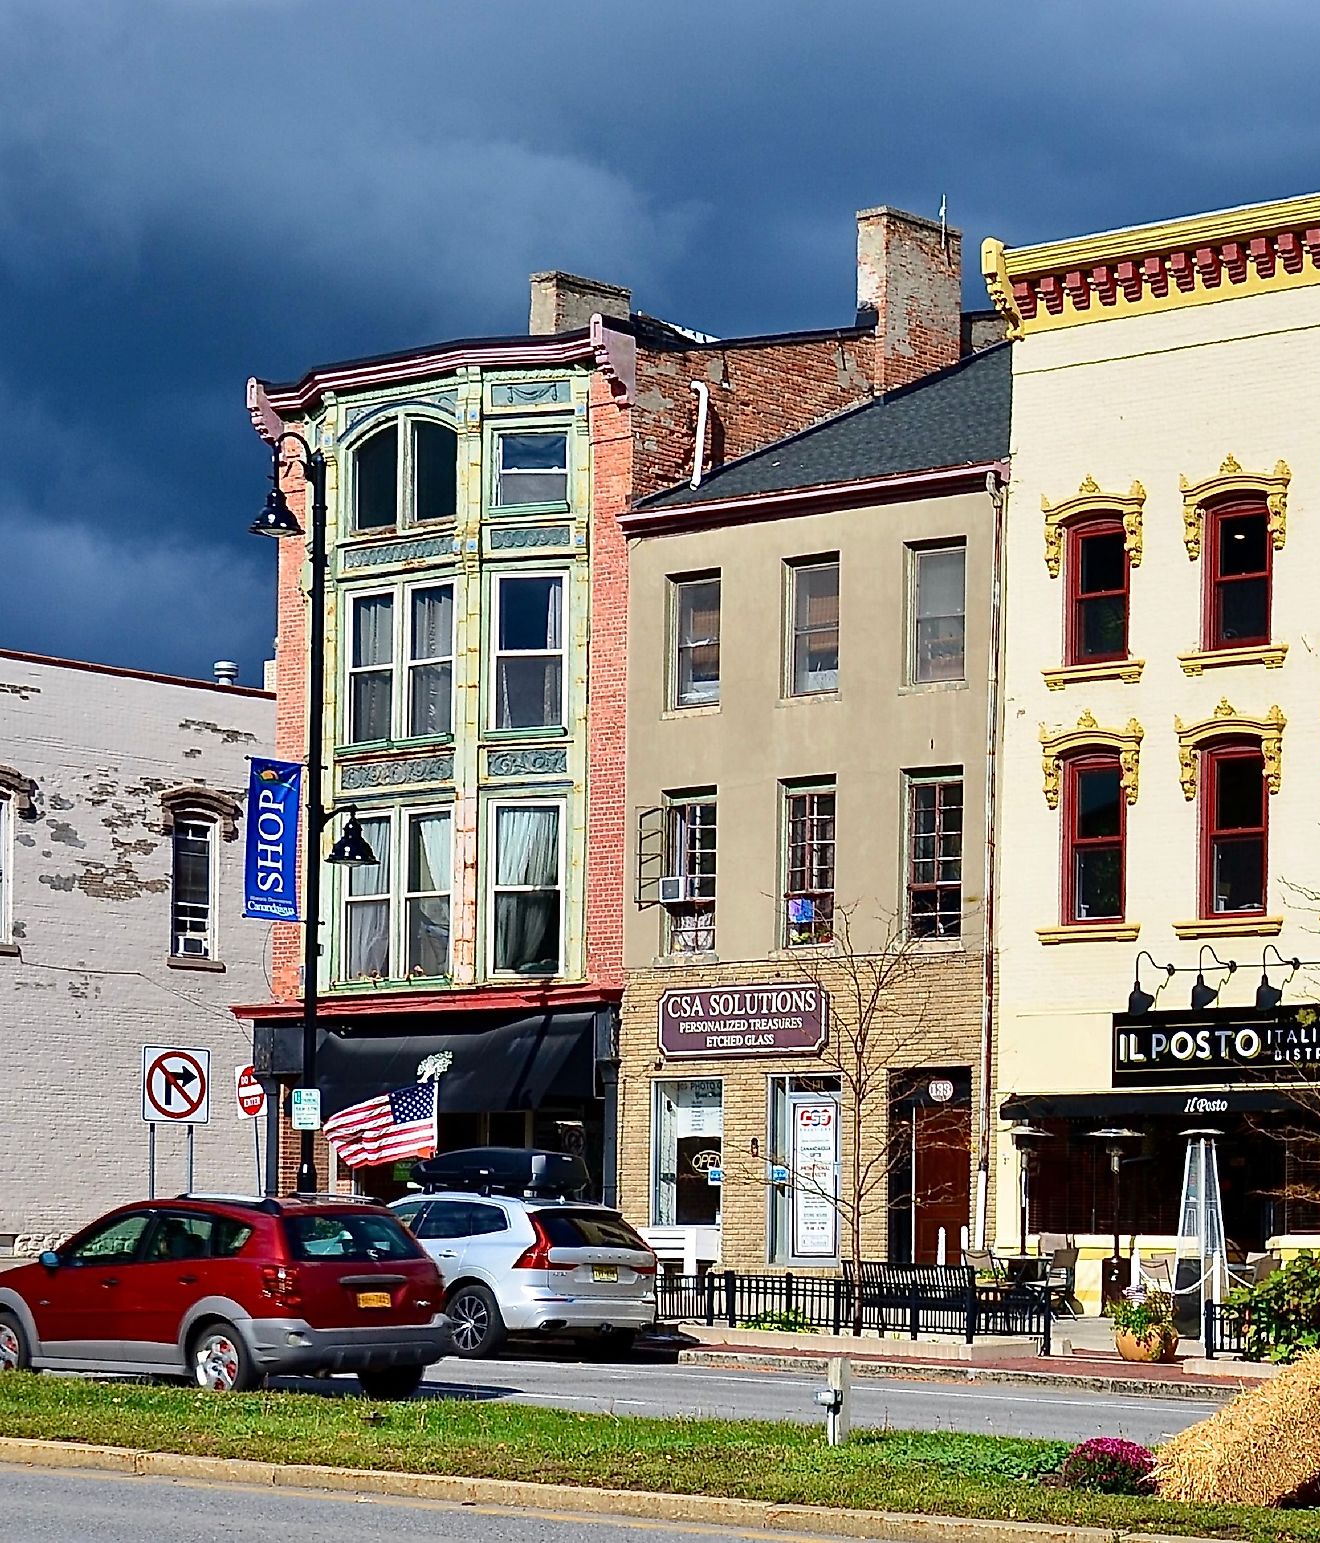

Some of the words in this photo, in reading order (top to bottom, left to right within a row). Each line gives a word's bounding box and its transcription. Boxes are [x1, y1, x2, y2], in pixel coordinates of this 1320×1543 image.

[257, 789, 285, 893] SHOP
[667, 995, 705, 1018] CSA
[709, 990, 816, 1016] SOLUTIONS
[679, 1019, 748, 1033] PERSONALIZED
[749, 1017, 803, 1030] TREASURES
[706, 1035, 743, 1048] ETCHED
[744, 1034, 775, 1047] GLASS
[1119, 1033, 1147, 1063] IL
[1151, 1028, 1262, 1062] POSTO
[690, 1081, 715, 1091] PHOTO
[1183, 1096, 1198, 1113] Il
[1196, 1098, 1228, 1113] Posto
[692, 1154, 721, 1169] OPEN
